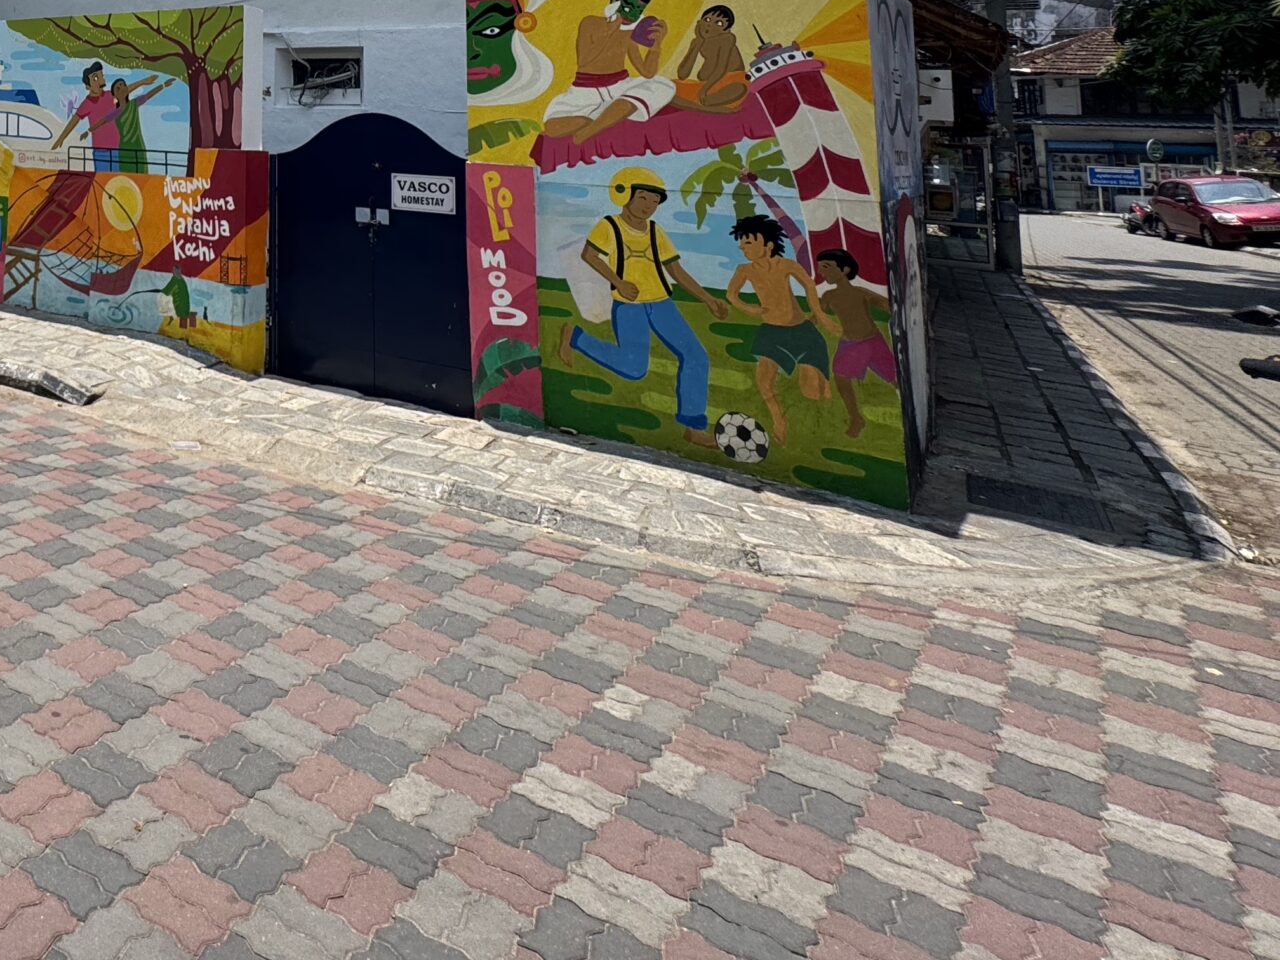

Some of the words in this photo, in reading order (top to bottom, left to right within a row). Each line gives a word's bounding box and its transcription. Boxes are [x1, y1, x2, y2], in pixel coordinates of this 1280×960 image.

[396, 179, 450, 195] VASCO
[401, 194, 445, 207] HOMESTAY
[173, 235, 215, 262] Kochi
